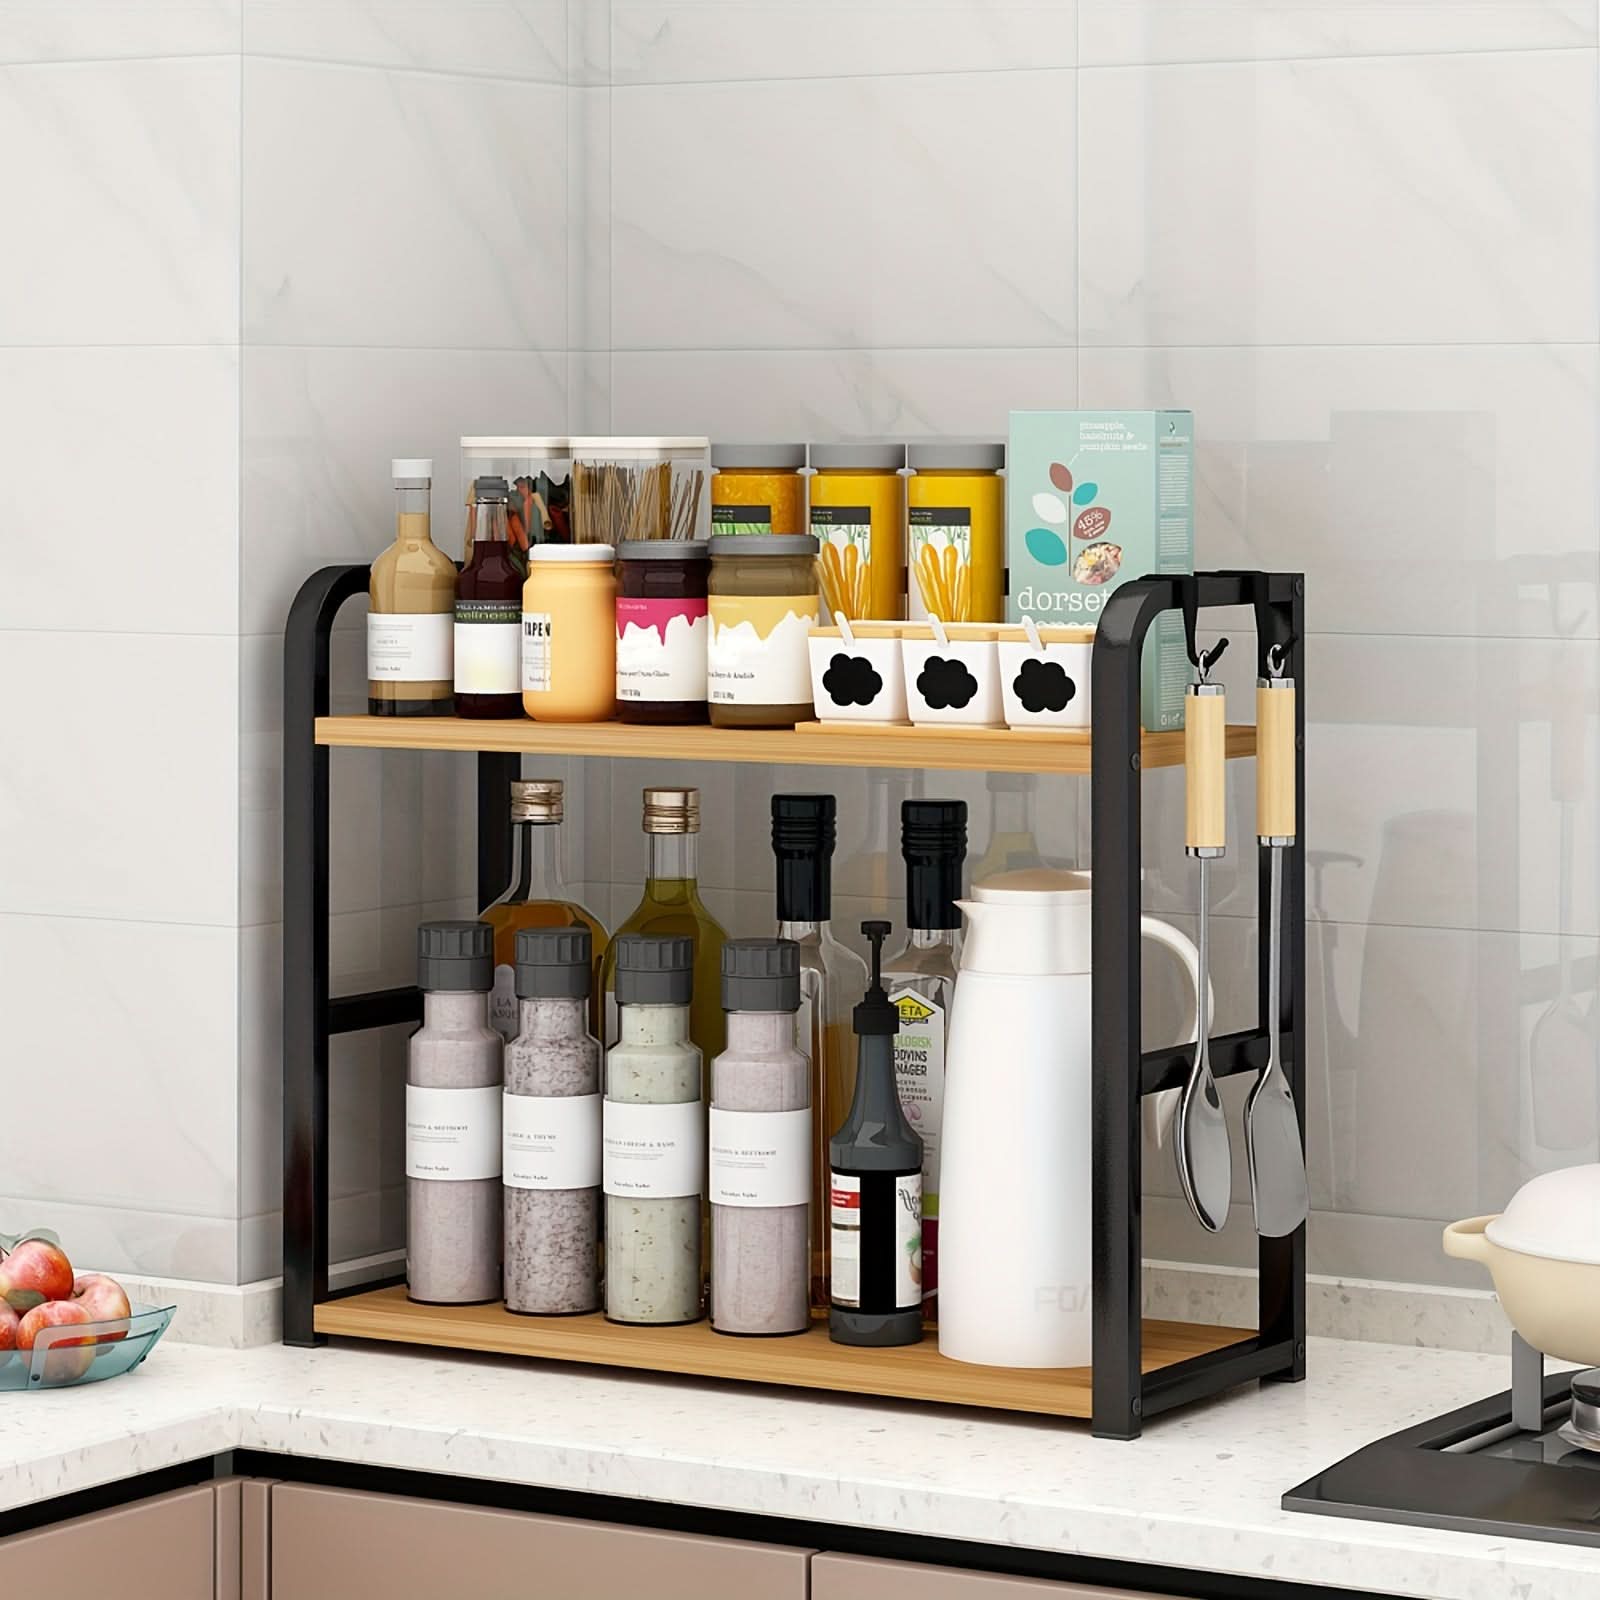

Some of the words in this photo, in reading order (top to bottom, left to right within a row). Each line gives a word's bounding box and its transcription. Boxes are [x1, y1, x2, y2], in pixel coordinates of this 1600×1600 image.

[1017, 586, 1111, 612] dorset
[900, 1005, 922, 1016] ETA
[896, 1061, 928, 1076] NÄGER
